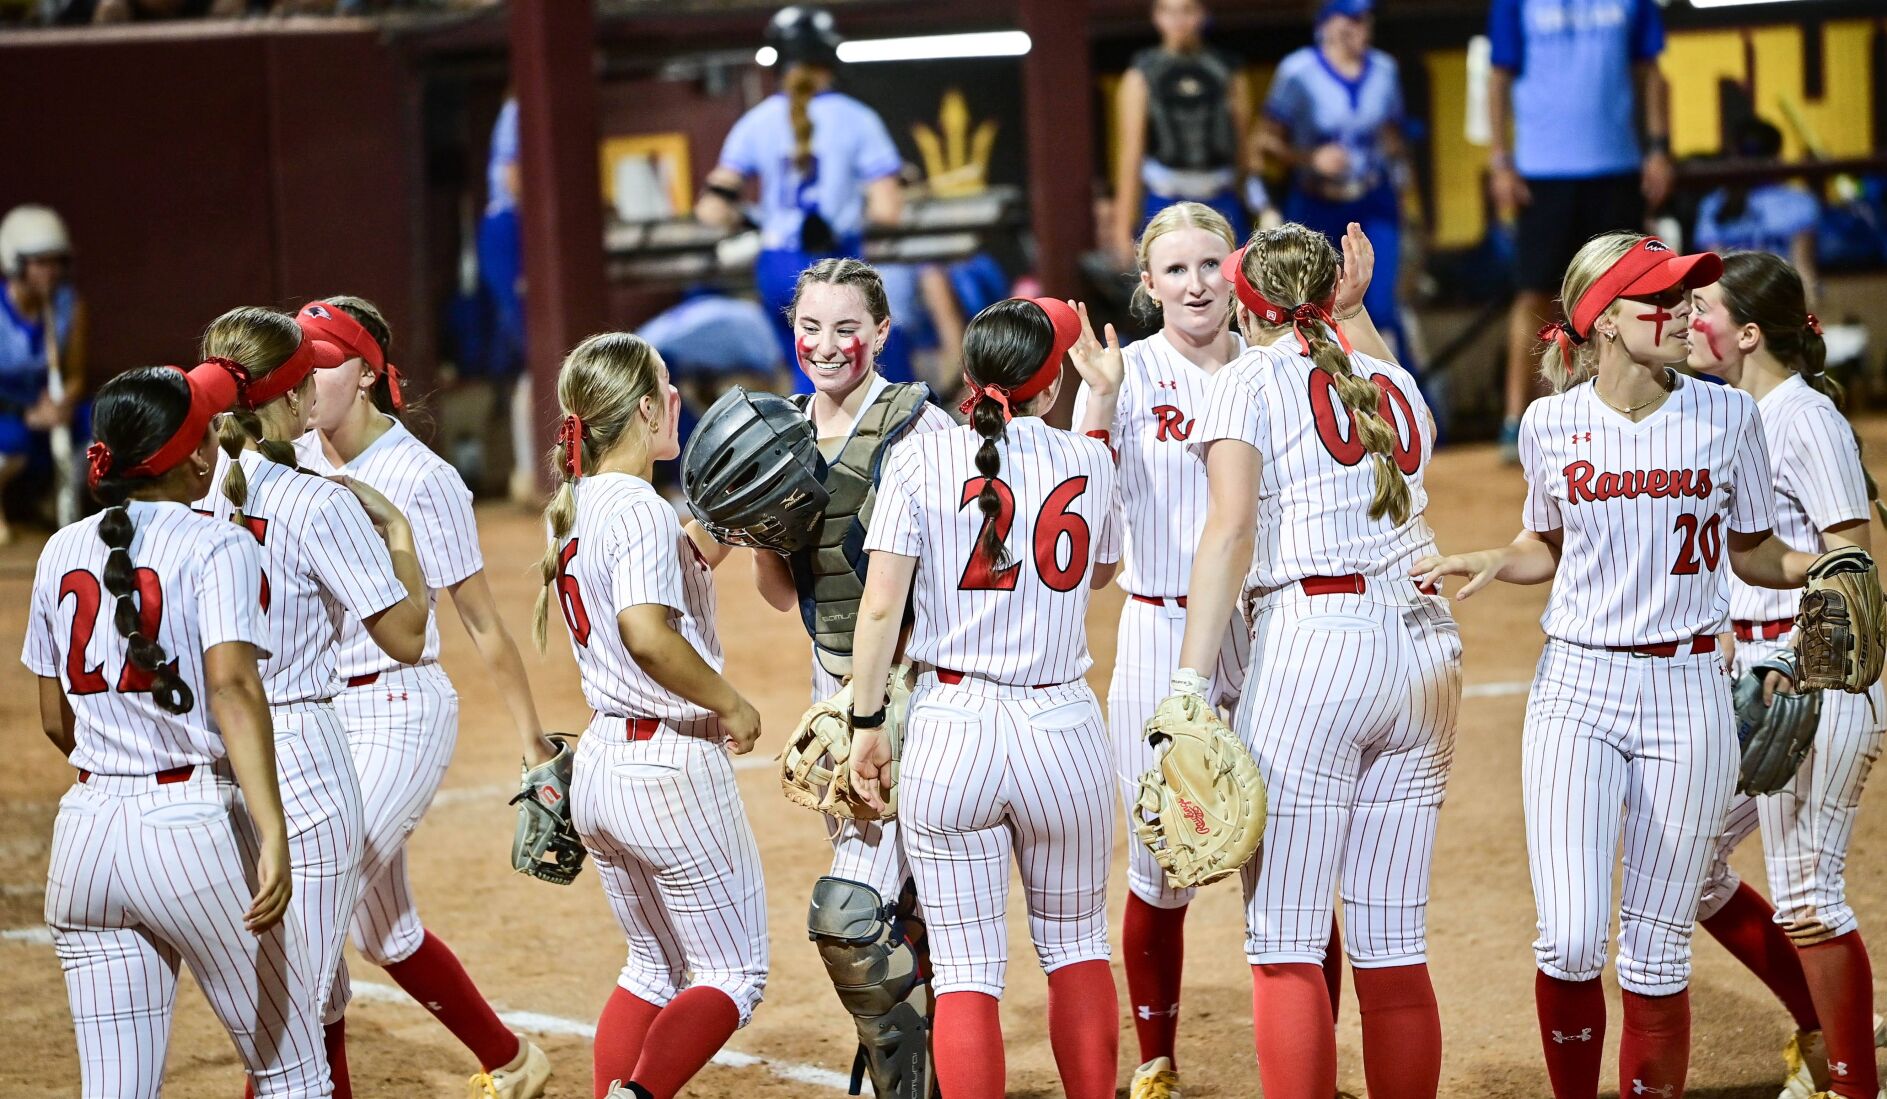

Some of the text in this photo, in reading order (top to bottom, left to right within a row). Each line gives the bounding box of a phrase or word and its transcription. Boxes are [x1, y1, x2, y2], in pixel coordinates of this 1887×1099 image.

[1308, 367, 1421, 476] 00
[1562, 459, 1713, 505] Ravens
[957, 475, 1090, 592] 26
[1670, 512, 1720, 575] 20
[57, 566, 179, 695] 22
[1179, 797, 1210, 834] Rawlings
